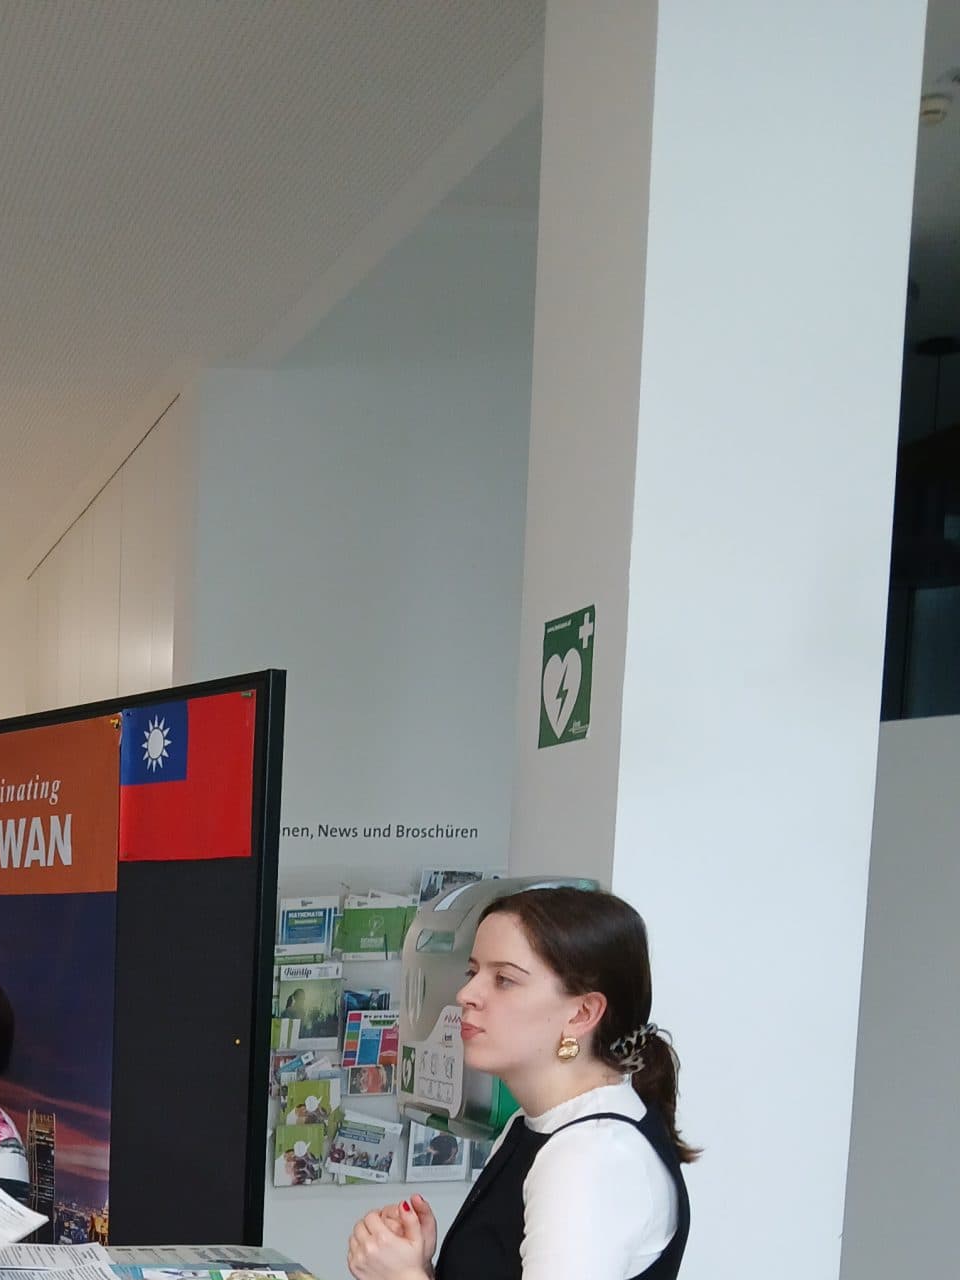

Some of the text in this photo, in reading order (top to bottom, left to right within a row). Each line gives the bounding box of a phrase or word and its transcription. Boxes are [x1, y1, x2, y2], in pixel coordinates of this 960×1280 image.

[318, 824, 358, 838] News
[363, 824, 391, 838] und
[396, 824, 478, 838] Broschüren
